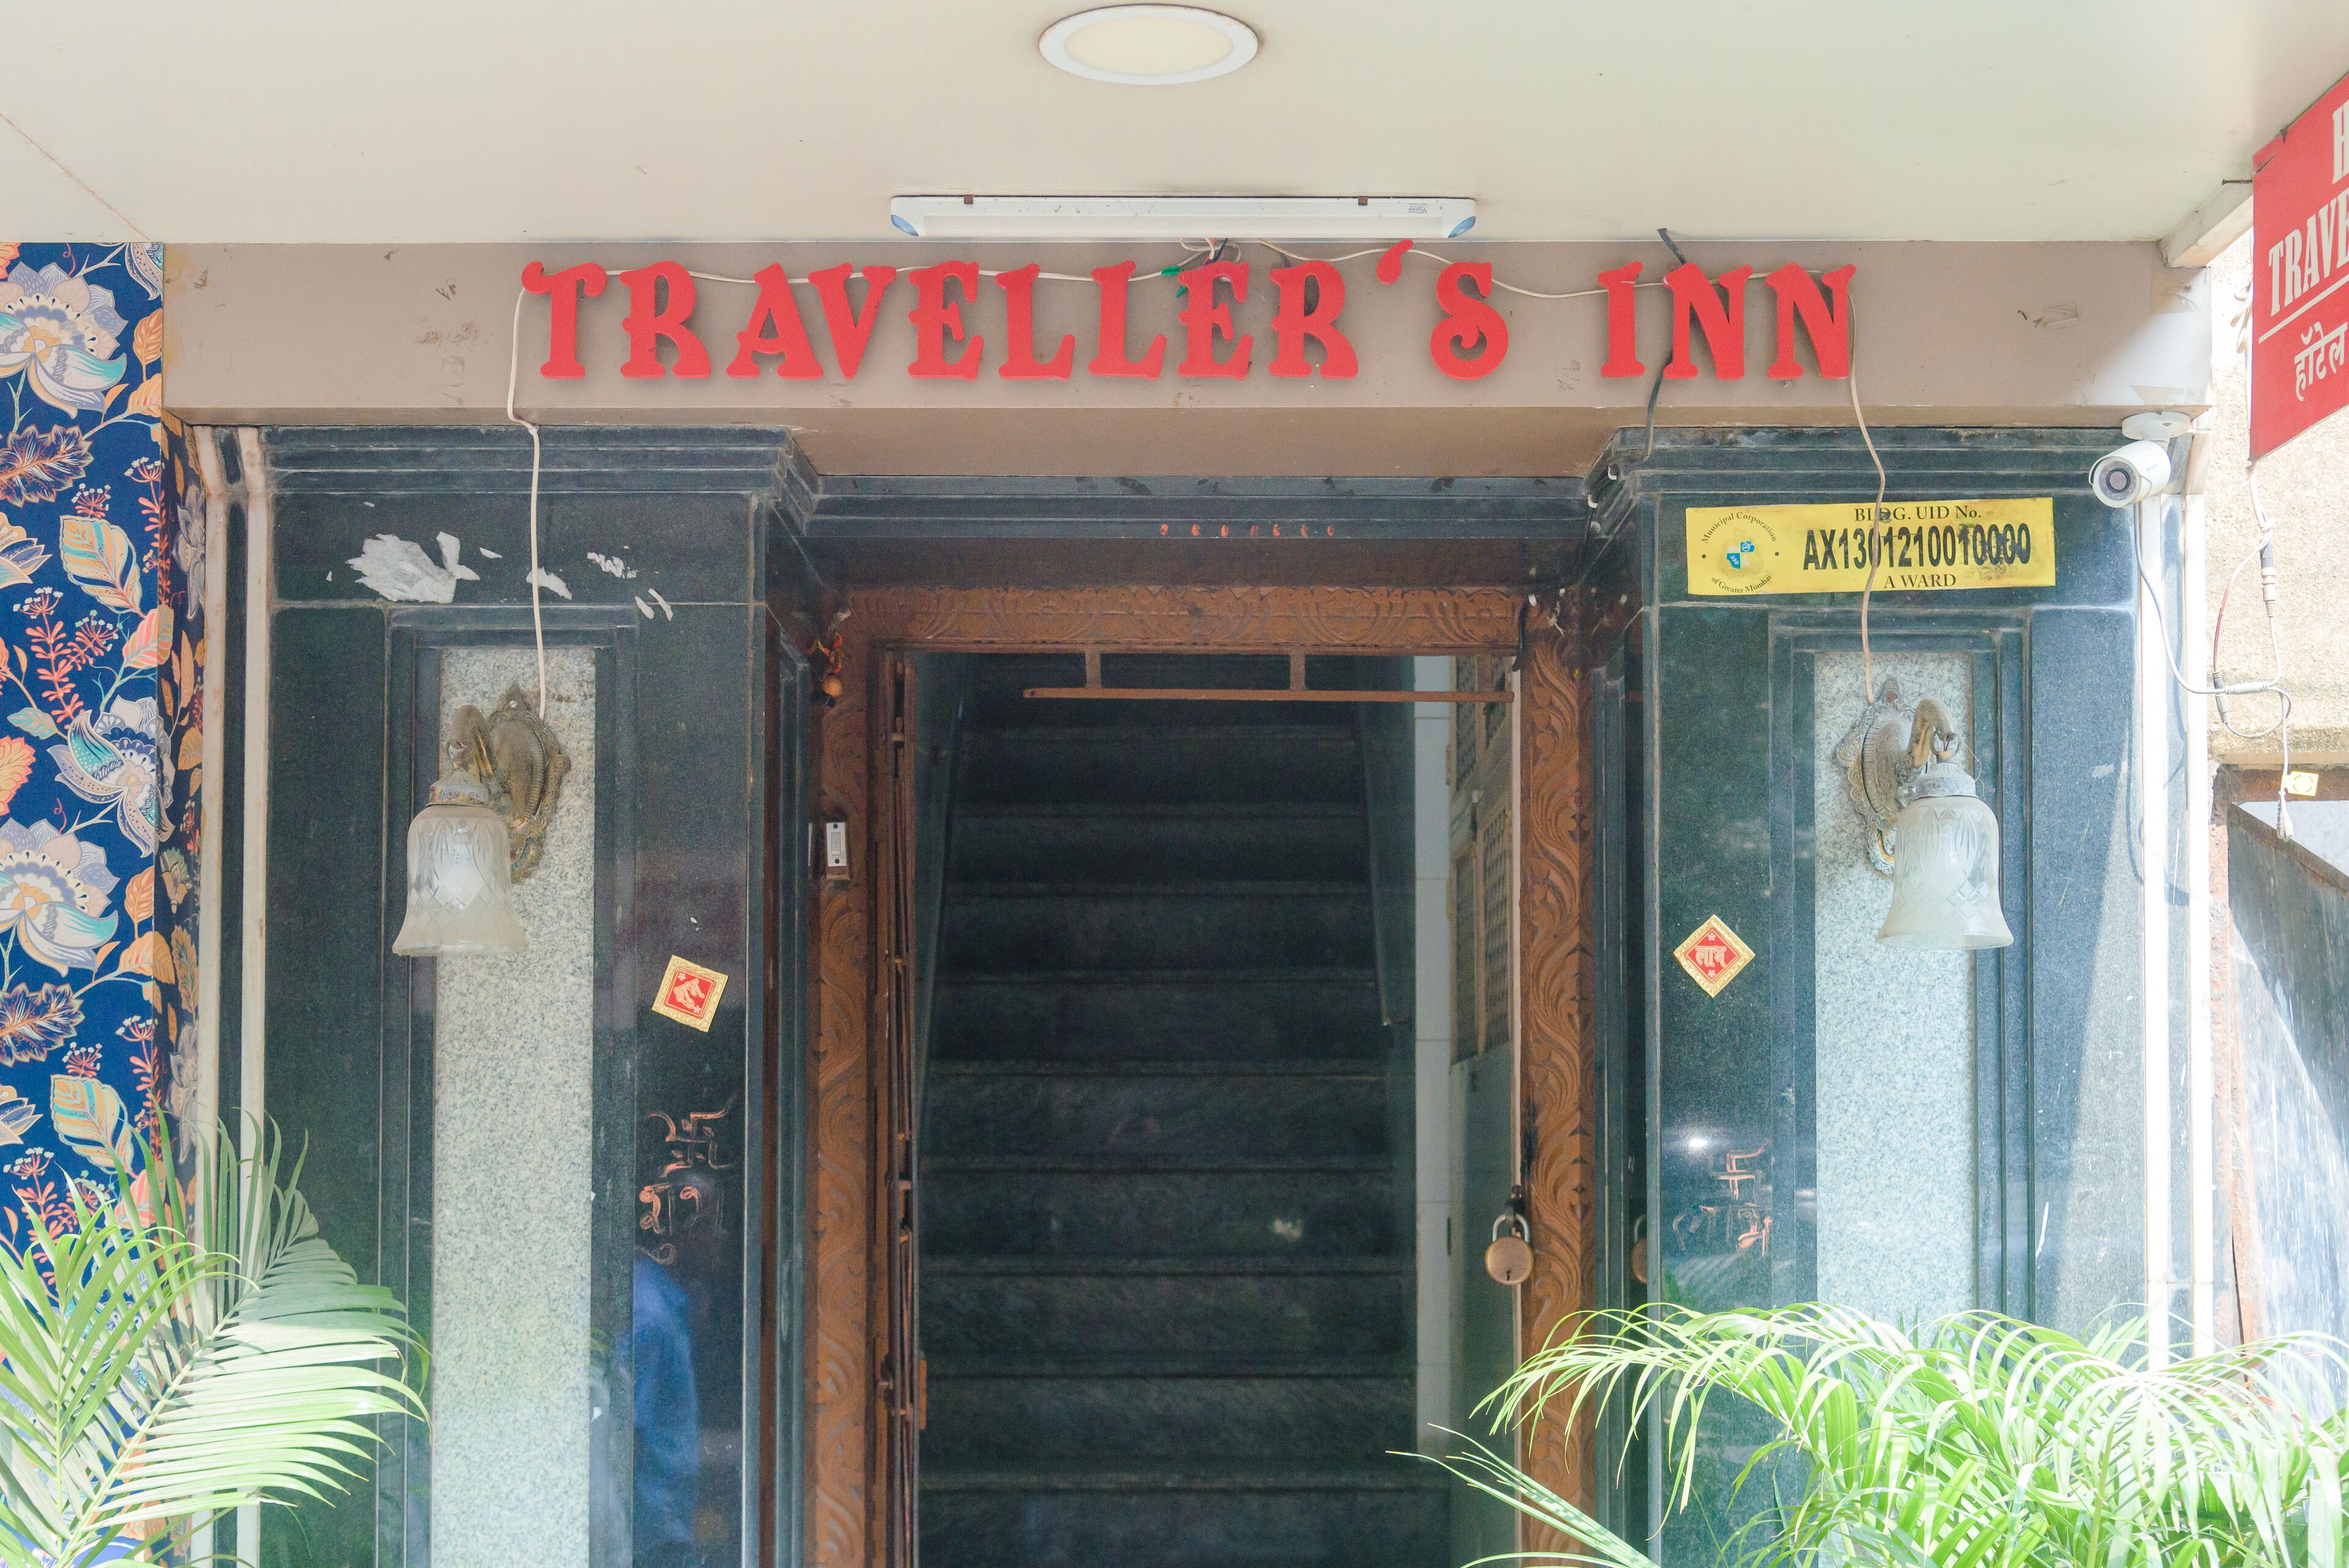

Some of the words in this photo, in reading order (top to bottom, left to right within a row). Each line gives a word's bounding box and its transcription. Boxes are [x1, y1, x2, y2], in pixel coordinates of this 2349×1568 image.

[521, 239, 1509, 381] TRAVELLER'S
[1598, 261, 1857, 381] INN
[2294, 321, 2348, 402] हॉटेल
[1915, 505, 1950, 519] UID
[1954, 505, 1982, 519] No.
[1701, 513, 1735, 544] Municipal
[1736, 511, 1777, 543] Corporation
[1718, 581, 1744, 593] Greater
[1745, 574, 1772, 593] Mumbai
[1883, 574, 1896, 589] A
[1900, 573, 1956, 589] WARD
[1695, 945, 1727, 968] लाभ
